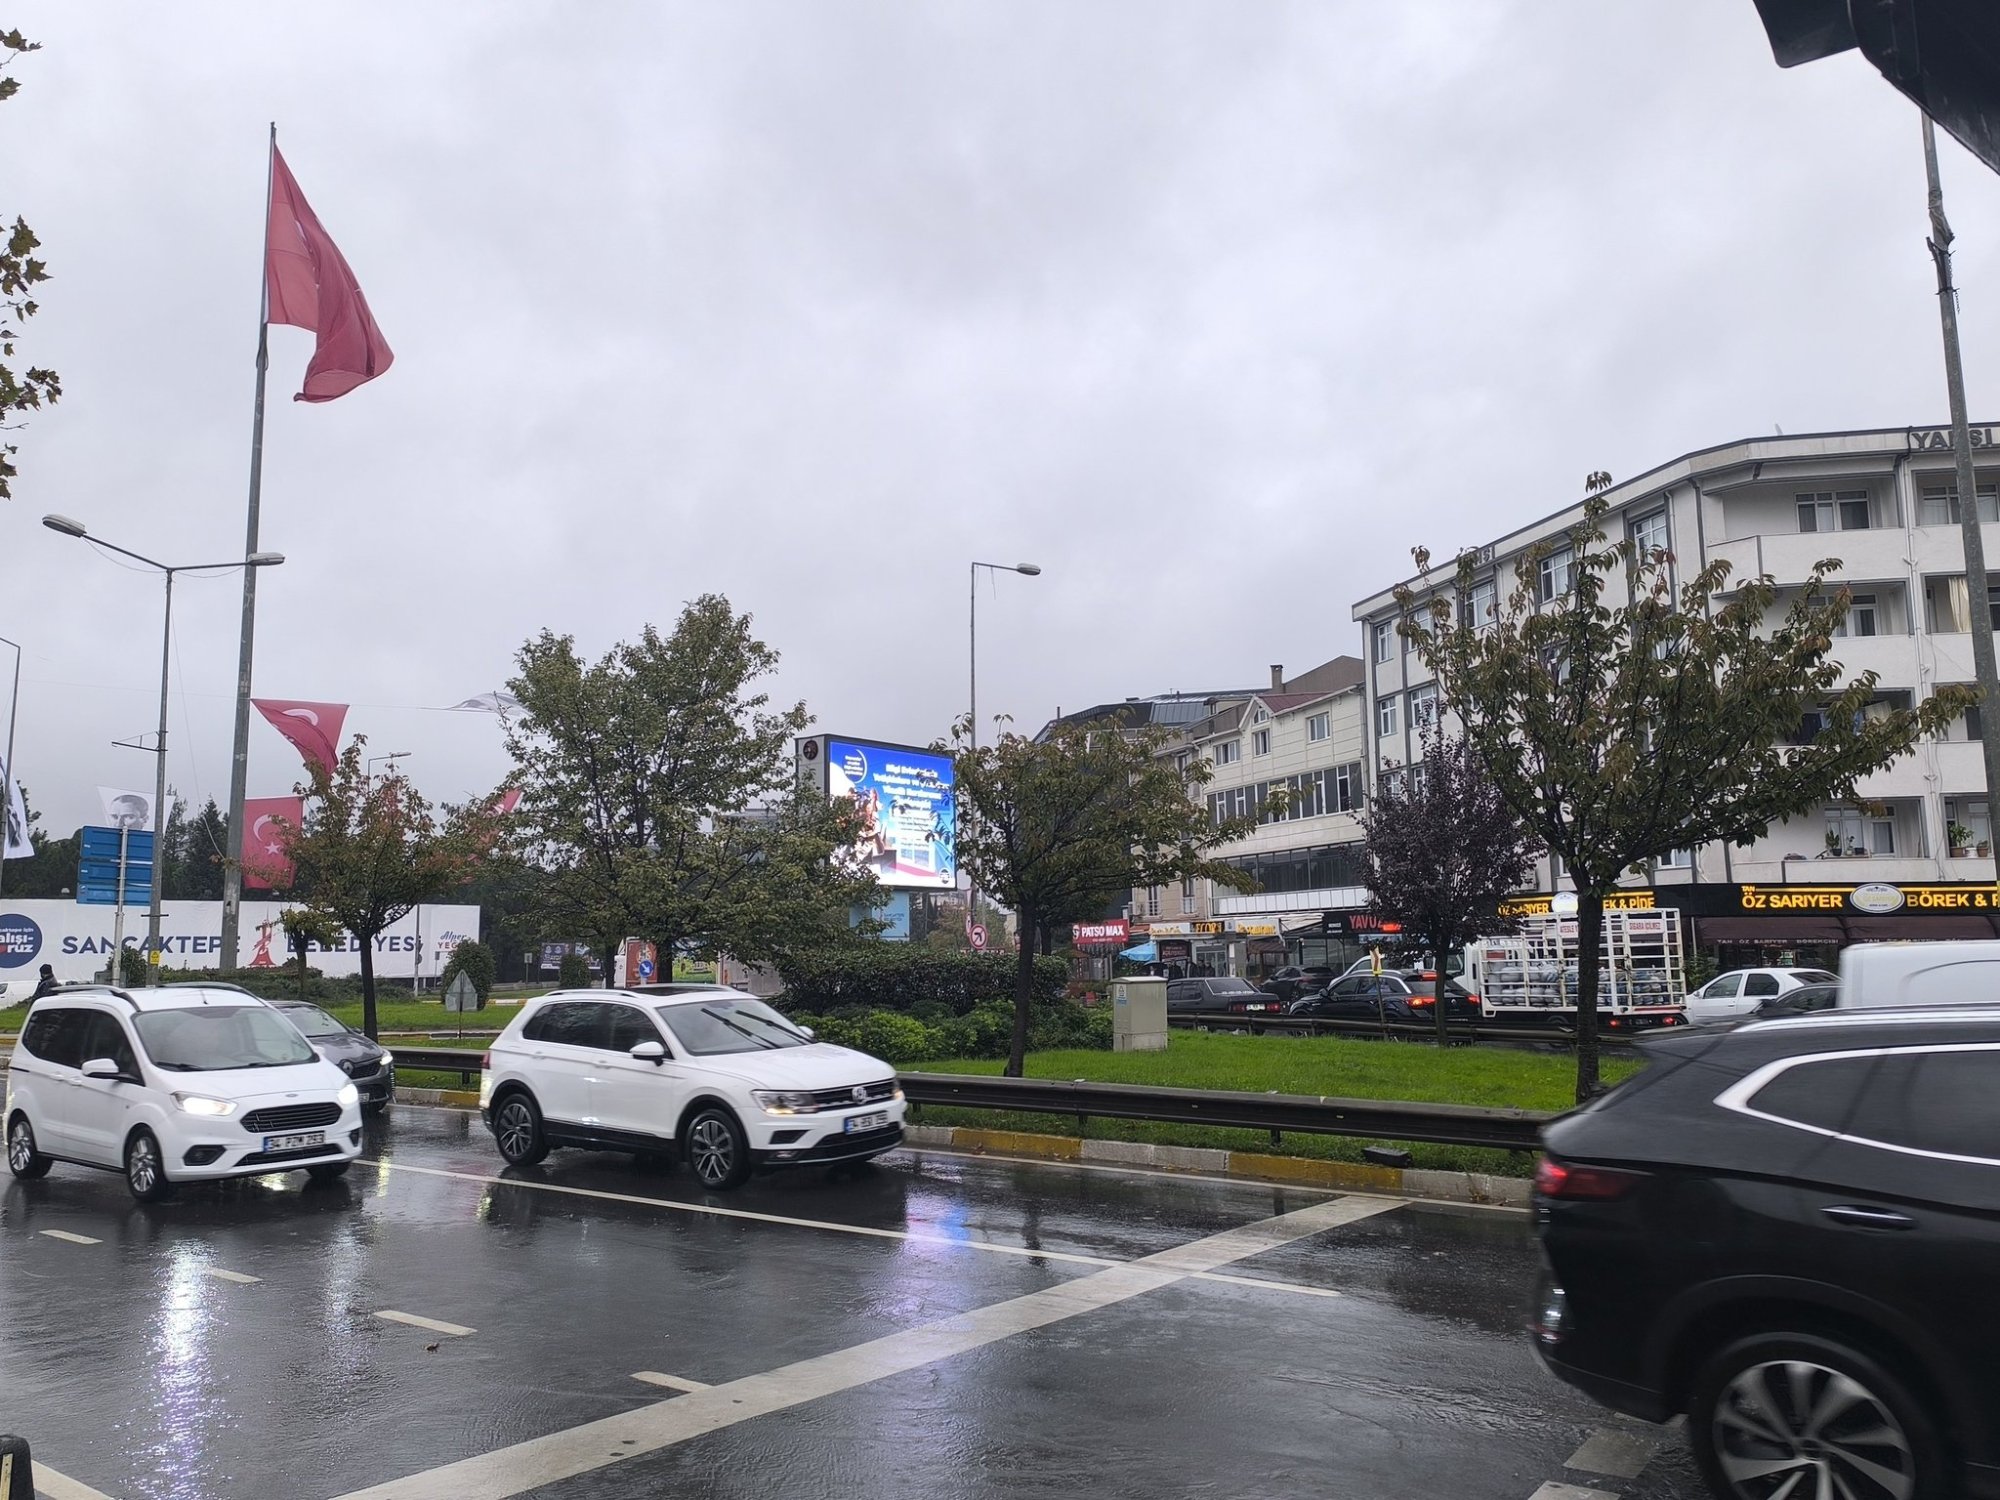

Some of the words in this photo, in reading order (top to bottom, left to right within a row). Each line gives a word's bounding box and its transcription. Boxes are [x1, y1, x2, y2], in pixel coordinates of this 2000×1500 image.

[1619, 898, 1629, 909] &
[1629, 896, 1655, 909] PİDE
[1742, 892, 1766, 908] ÖZ
[1769, 894, 1843, 909] SARIYER
[1907, 890, 1969, 908] BÖREK
[1974, 893, 1987, 907] &
[1082, 926, 1104, 938] PATSO
[1106, 925, 1125, 937] MAX
[62, 936, 241, 954] SANCAKTEP
